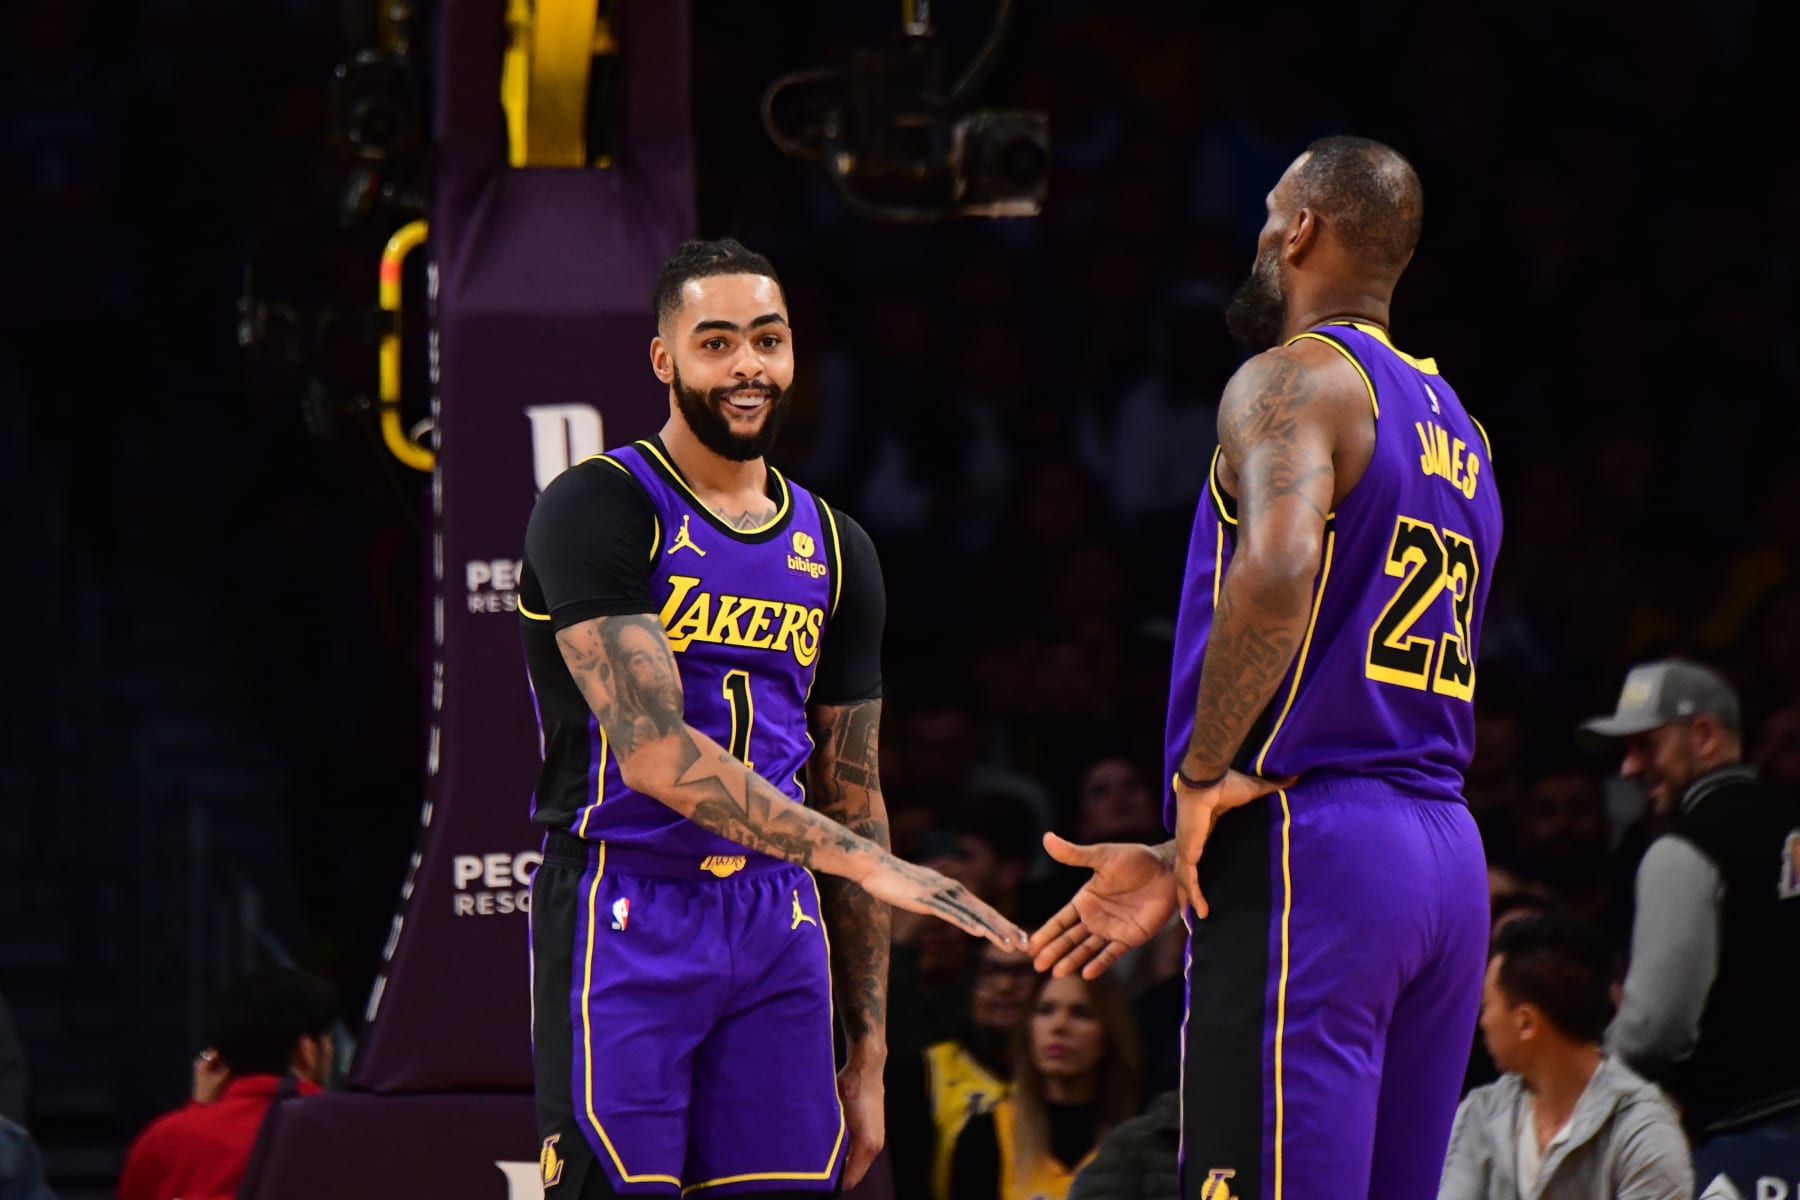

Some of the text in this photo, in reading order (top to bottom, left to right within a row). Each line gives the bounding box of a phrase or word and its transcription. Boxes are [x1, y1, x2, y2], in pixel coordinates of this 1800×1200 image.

[1416, 420, 1479, 500] JAMES
[787, 554, 826, 578] bibigo
[1366, 515, 1479, 703] 23
[659, 574, 824, 666] LAKERS
[722, 669, 754, 770] 1
[700, 855, 746, 872] LAKERS
